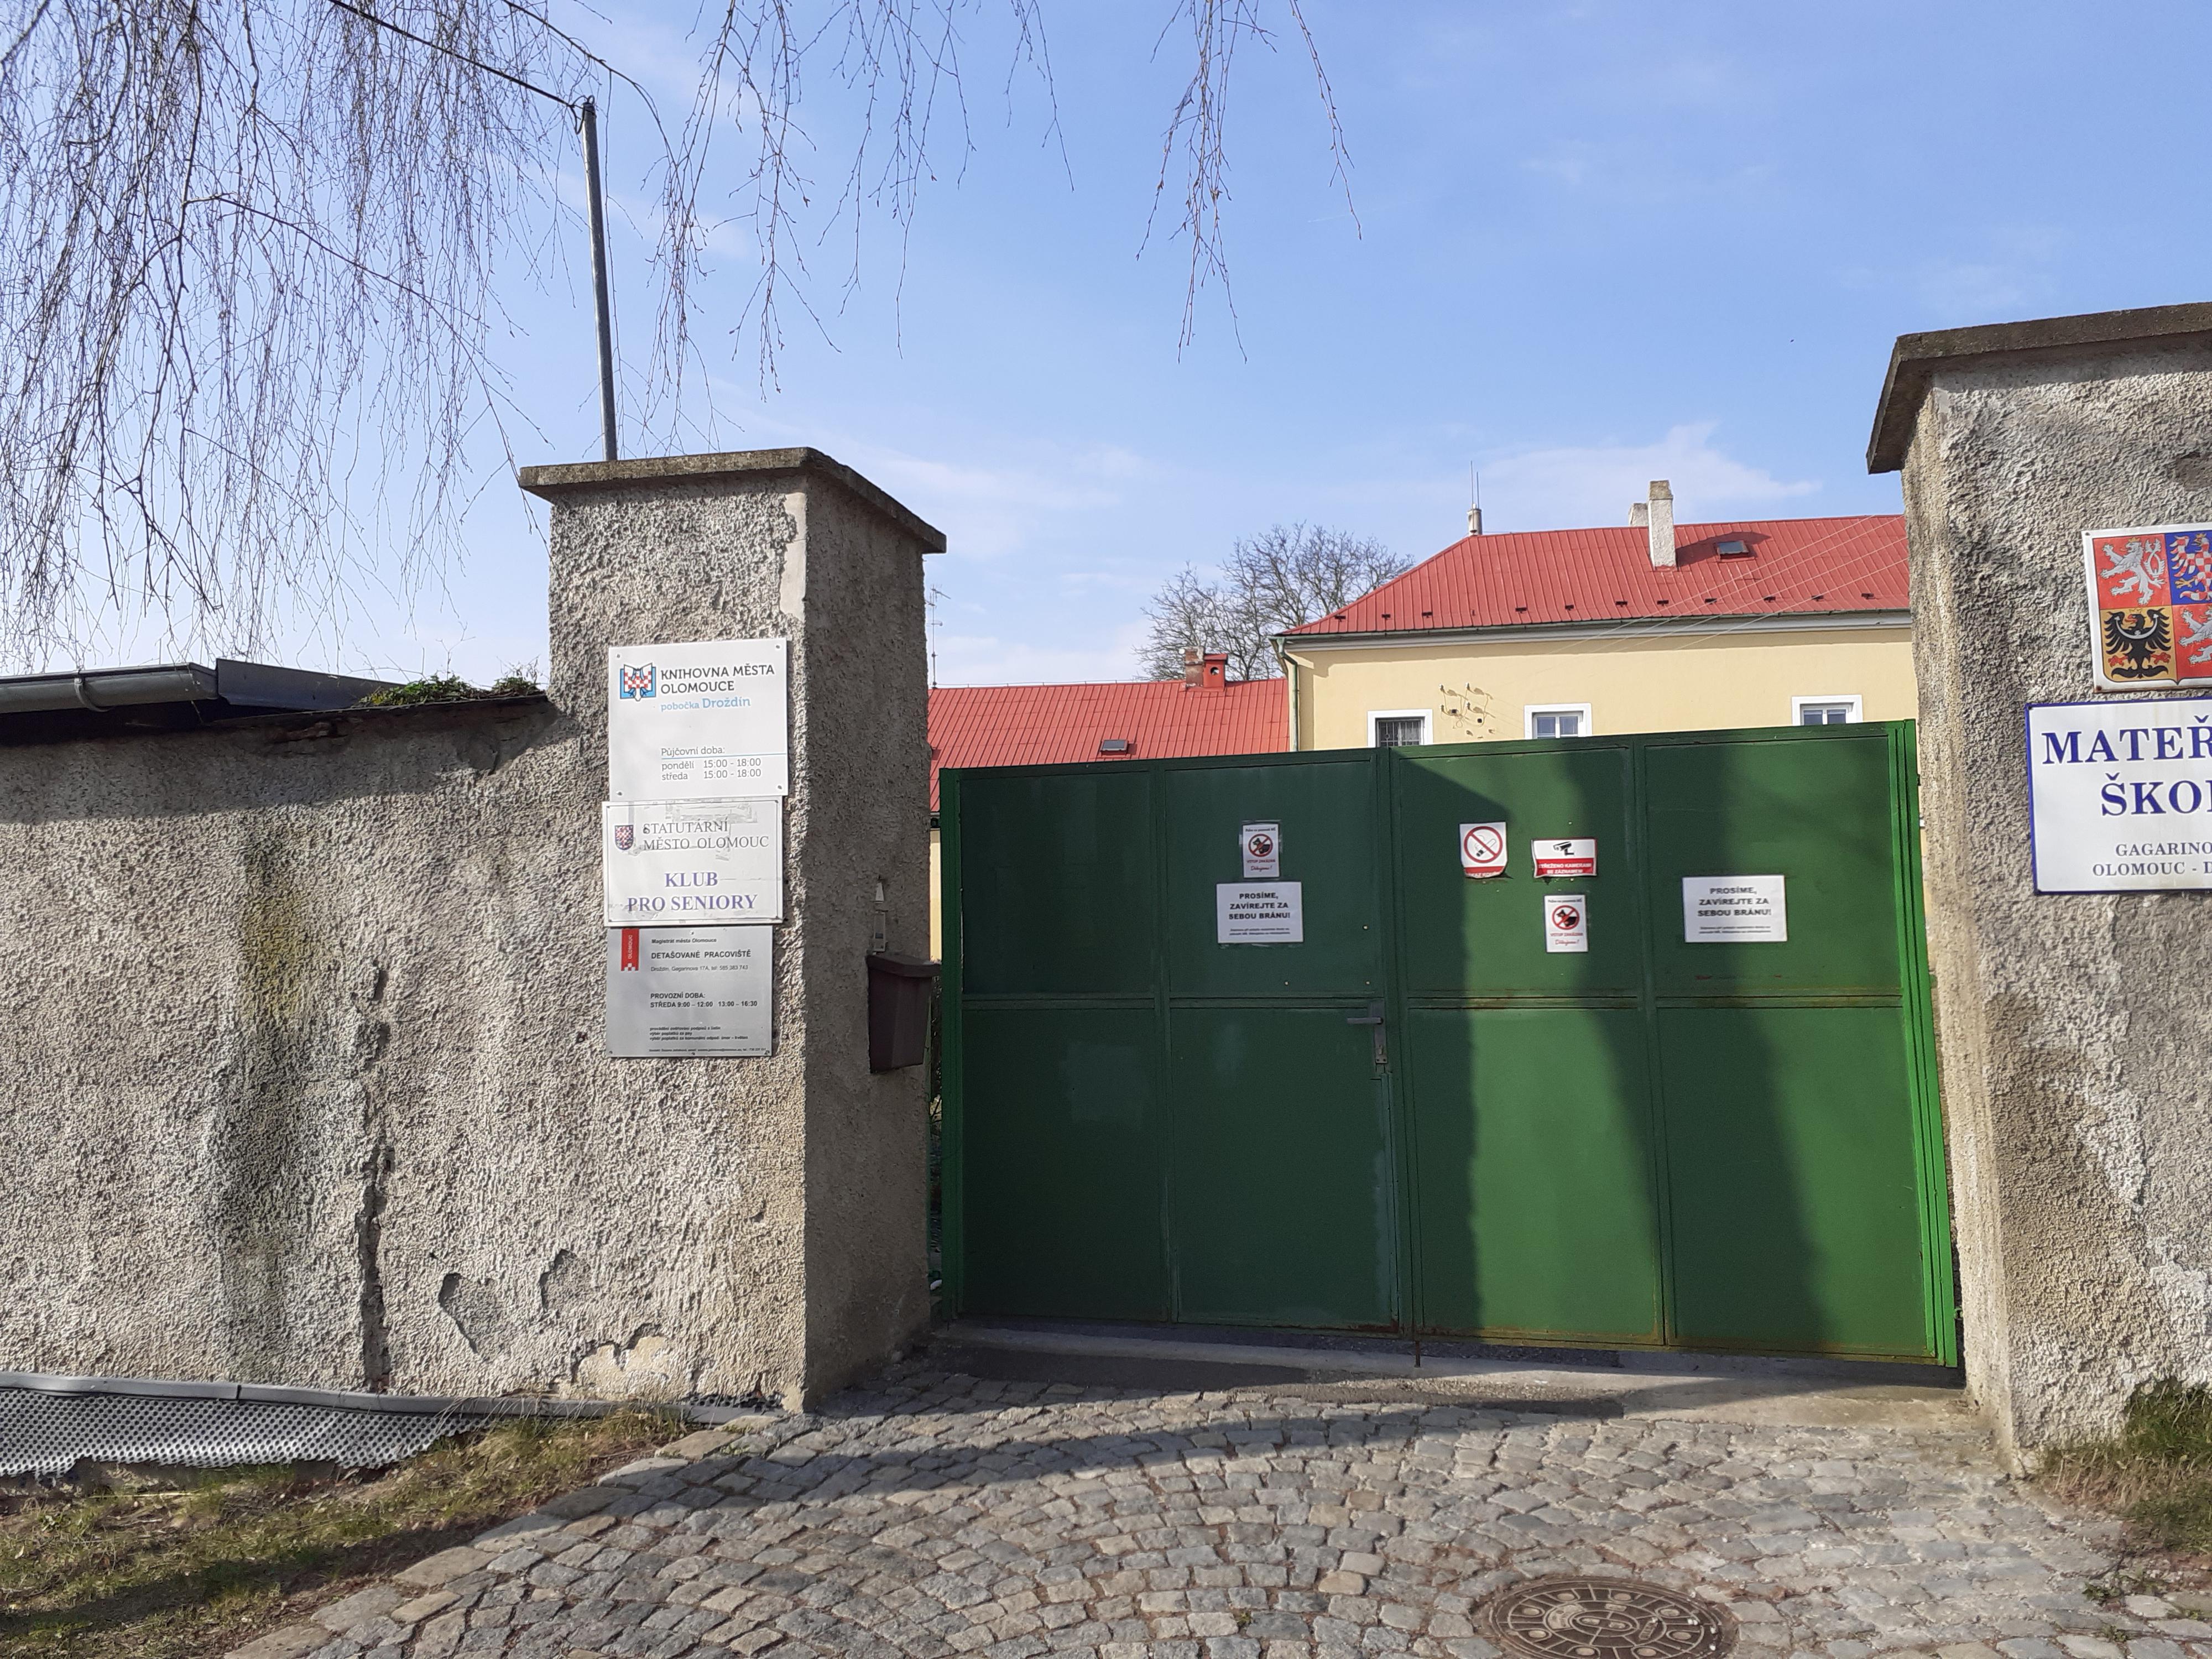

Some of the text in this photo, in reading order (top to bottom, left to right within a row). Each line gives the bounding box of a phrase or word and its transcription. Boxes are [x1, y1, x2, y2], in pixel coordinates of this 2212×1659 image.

[661, 663, 774, 680] KNIHOVNA MĚSTA
[661, 681, 734, 694] OLOMOUCE
[661, 696, 750, 712] pobočka Droždín
[2041, 715, 2212, 764] MATEŘ
[661, 747, 725, 757] Půjčovní doba:
[661, 761, 694, 771] pondělí
[703, 759, 728, 768] 15:00
[737, 758, 761, 766] 18:00
[662, 772, 688, 780] středa
[703, 770, 728, 779] 15:00
[737, 769, 761, 778] 18:00
[2101, 773, 2212, 816] ŠKO
[643, 818, 728, 834] STATUTÁRNÍ
[643, 836, 769, 850] MĚSTO OLOMOUC
[2093, 862, 2185, 877] OLOMOUC
[665, 872, 718, 887] KLUB
[628, 894, 758, 911] PRO SENIORY
[1699, 897, 1754, 906] ZAVÍREJTE
[1259, 911, 1291, 919] BRÁNU!
[651, 949, 751, 959] DETAŠOVANÉ PRACOVIŠTĚ
